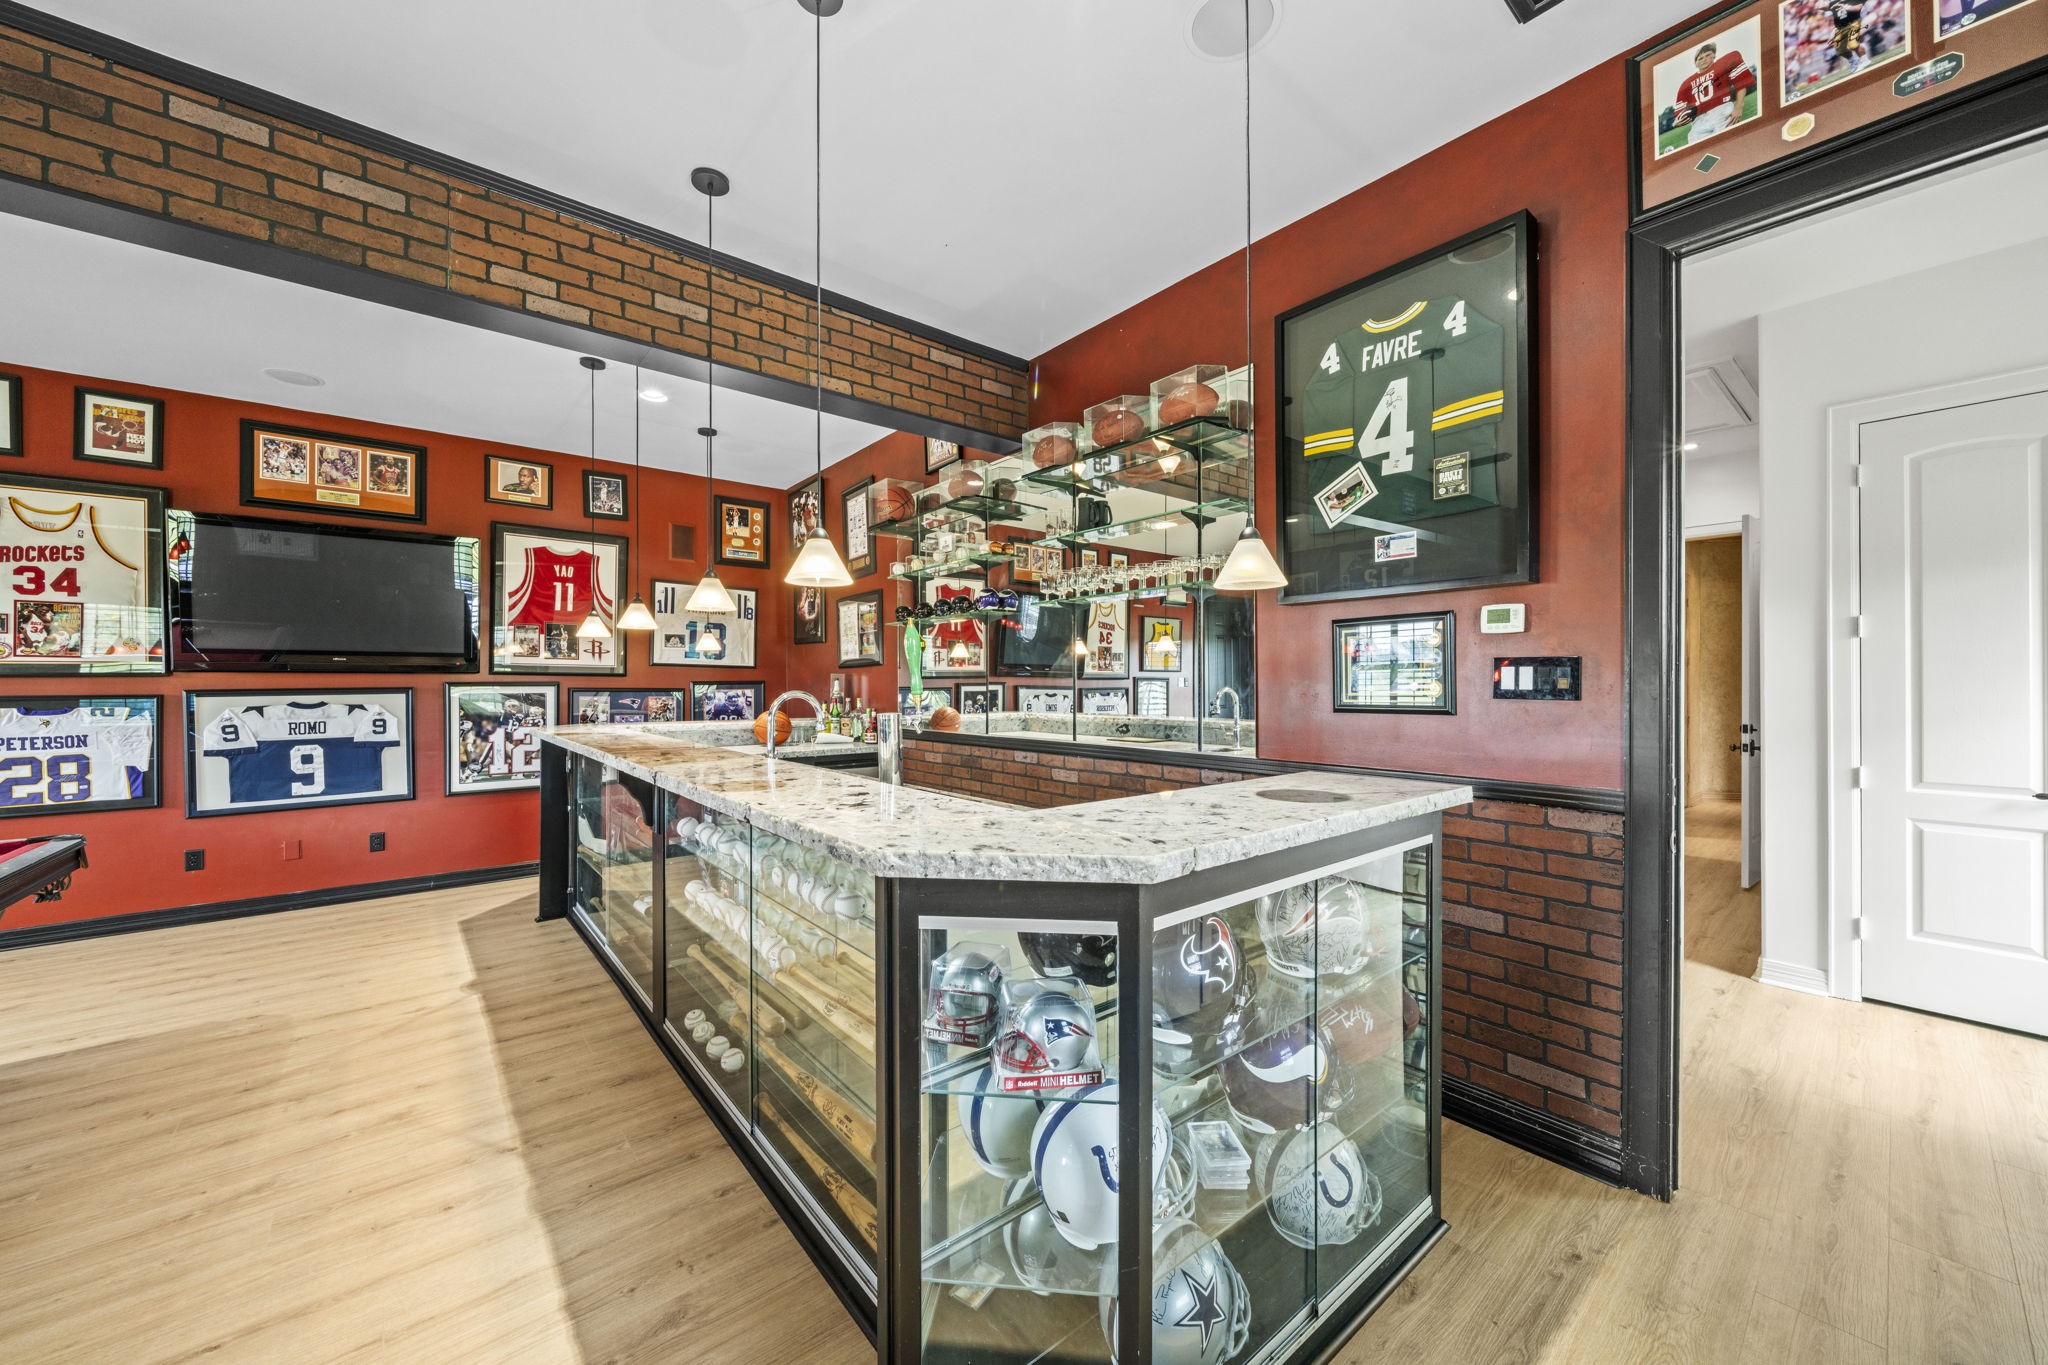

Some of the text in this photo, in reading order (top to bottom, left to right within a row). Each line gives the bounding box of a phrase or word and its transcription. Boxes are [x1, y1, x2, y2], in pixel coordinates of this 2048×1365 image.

[1691, 70, 1715, 88] HAWKS
[1692, 80, 1714, 106] 10
[1443, 300, 1467, 337] 4
[1320, 342, 1341, 375] 4
[1362, 330, 1423, 372] FAVRE
[1358, 376, 1415, 477] 4
[12, 565, 81, 597] 34
[553, 564, 574, 578] YAO
[553, 582, 574, 612] 11
[746, 607, 754, 620] 8
[221, 724, 240, 743] 9
[288, 720, 327, 736] ROMO
[372, 718, 387, 735] 9
[488, 727, 541, 776] 12
[0, 753, 93, 808] 28
[289, 744, 326, 796] 9
[1017, 1079, 1038, 1088] Riddell
[1040, 1076, 1058, 1087] MINI
[1059, 1073, 1099, 1086] HELMET
